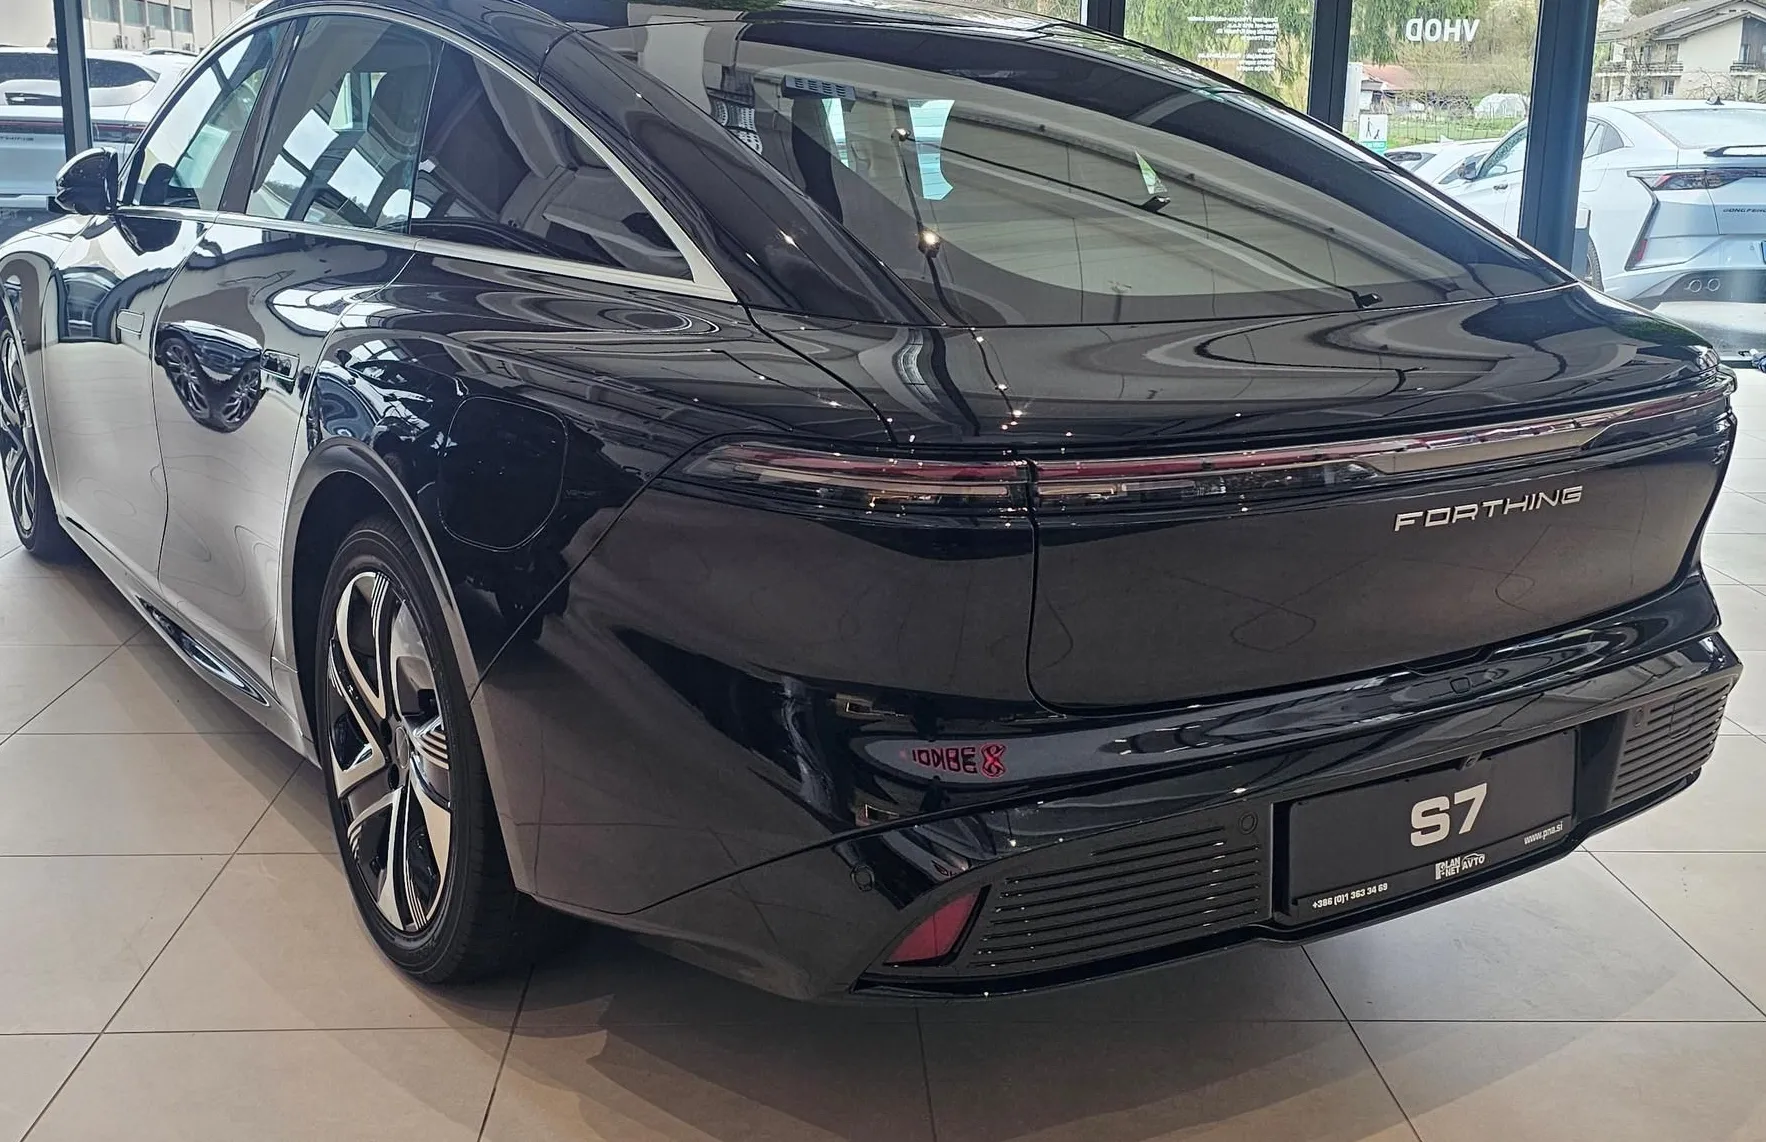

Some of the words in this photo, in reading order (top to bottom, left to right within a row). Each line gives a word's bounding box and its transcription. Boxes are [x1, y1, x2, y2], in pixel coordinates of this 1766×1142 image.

[1394, 485, 1583, 532] FORTHING
[1411, 783, 1487, 847] S7
[1461, 854, 1486, 870] AVTO
[1334, 893, 1349, 906] (0)1
[1350, 889, 1366, 899] 363
[1366, 886, 1377, 895] 34
